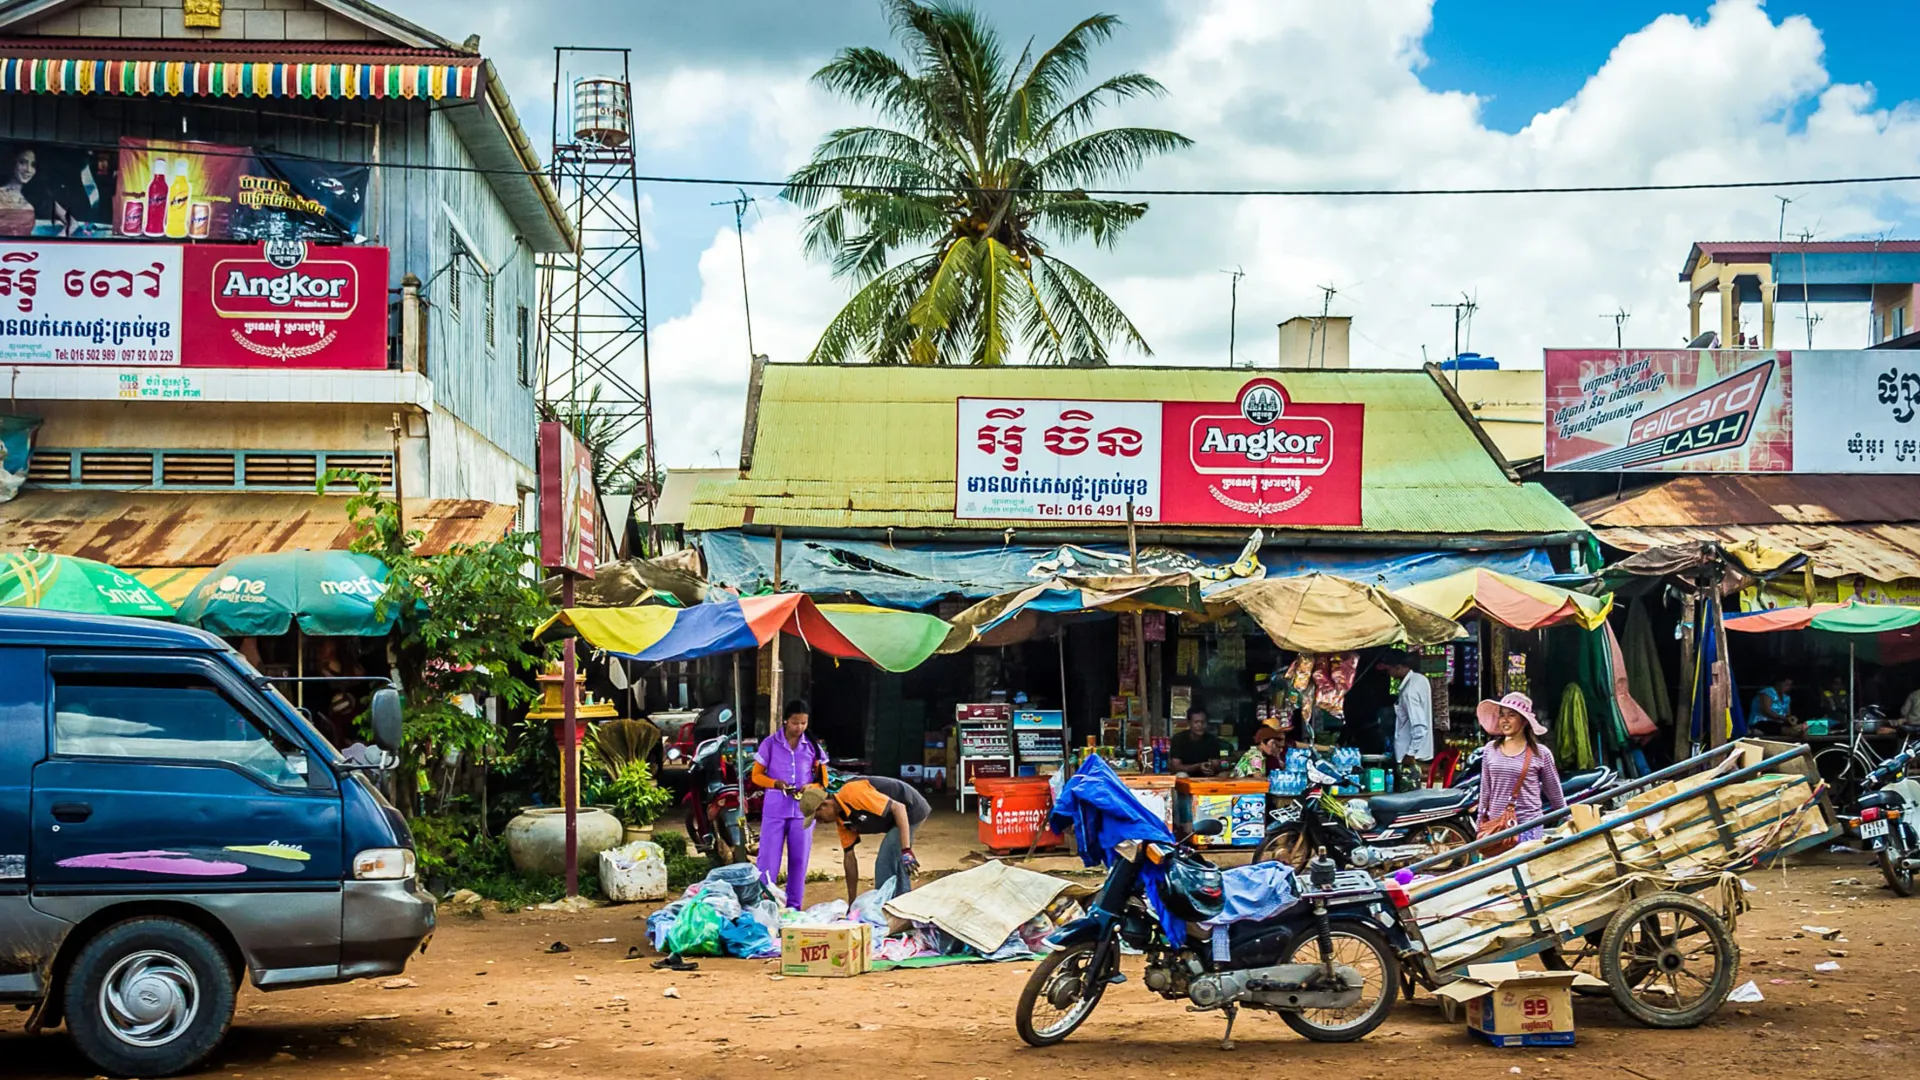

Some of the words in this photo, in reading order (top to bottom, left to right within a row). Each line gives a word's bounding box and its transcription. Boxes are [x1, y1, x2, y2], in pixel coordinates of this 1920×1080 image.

[223, 271, 346, 304] Angkor
[55, 349, 69, 360] Tel:
[70, 349, 84, 360] 016
[86, 349, 100, 360] 502
[102, 349, 116, 360] 989
[122, 350, 135, 361] 097
[137, 350, 146, 361] 92
[149, 350, 158, 361] 00
[160, 350, 173, 361] 229
[1630, 372, 1762, 443] cellcard
[1662, 414, 1744, 454] CASH
[1200, 427, 1323, 461] Angkor
[1306, 457, 1324, 465] Beer
[1037, 504, 1062, 515] Tel:
[1067, 504, 1092, 516] 016
[1097, 505, 1121, 516] 491
[1132, 506, 1153, 517] 49
[97, 585, 156, 604] Smart
[800, 944, 830, 963] NET
[1524, 999, 1548, 1016] 99
